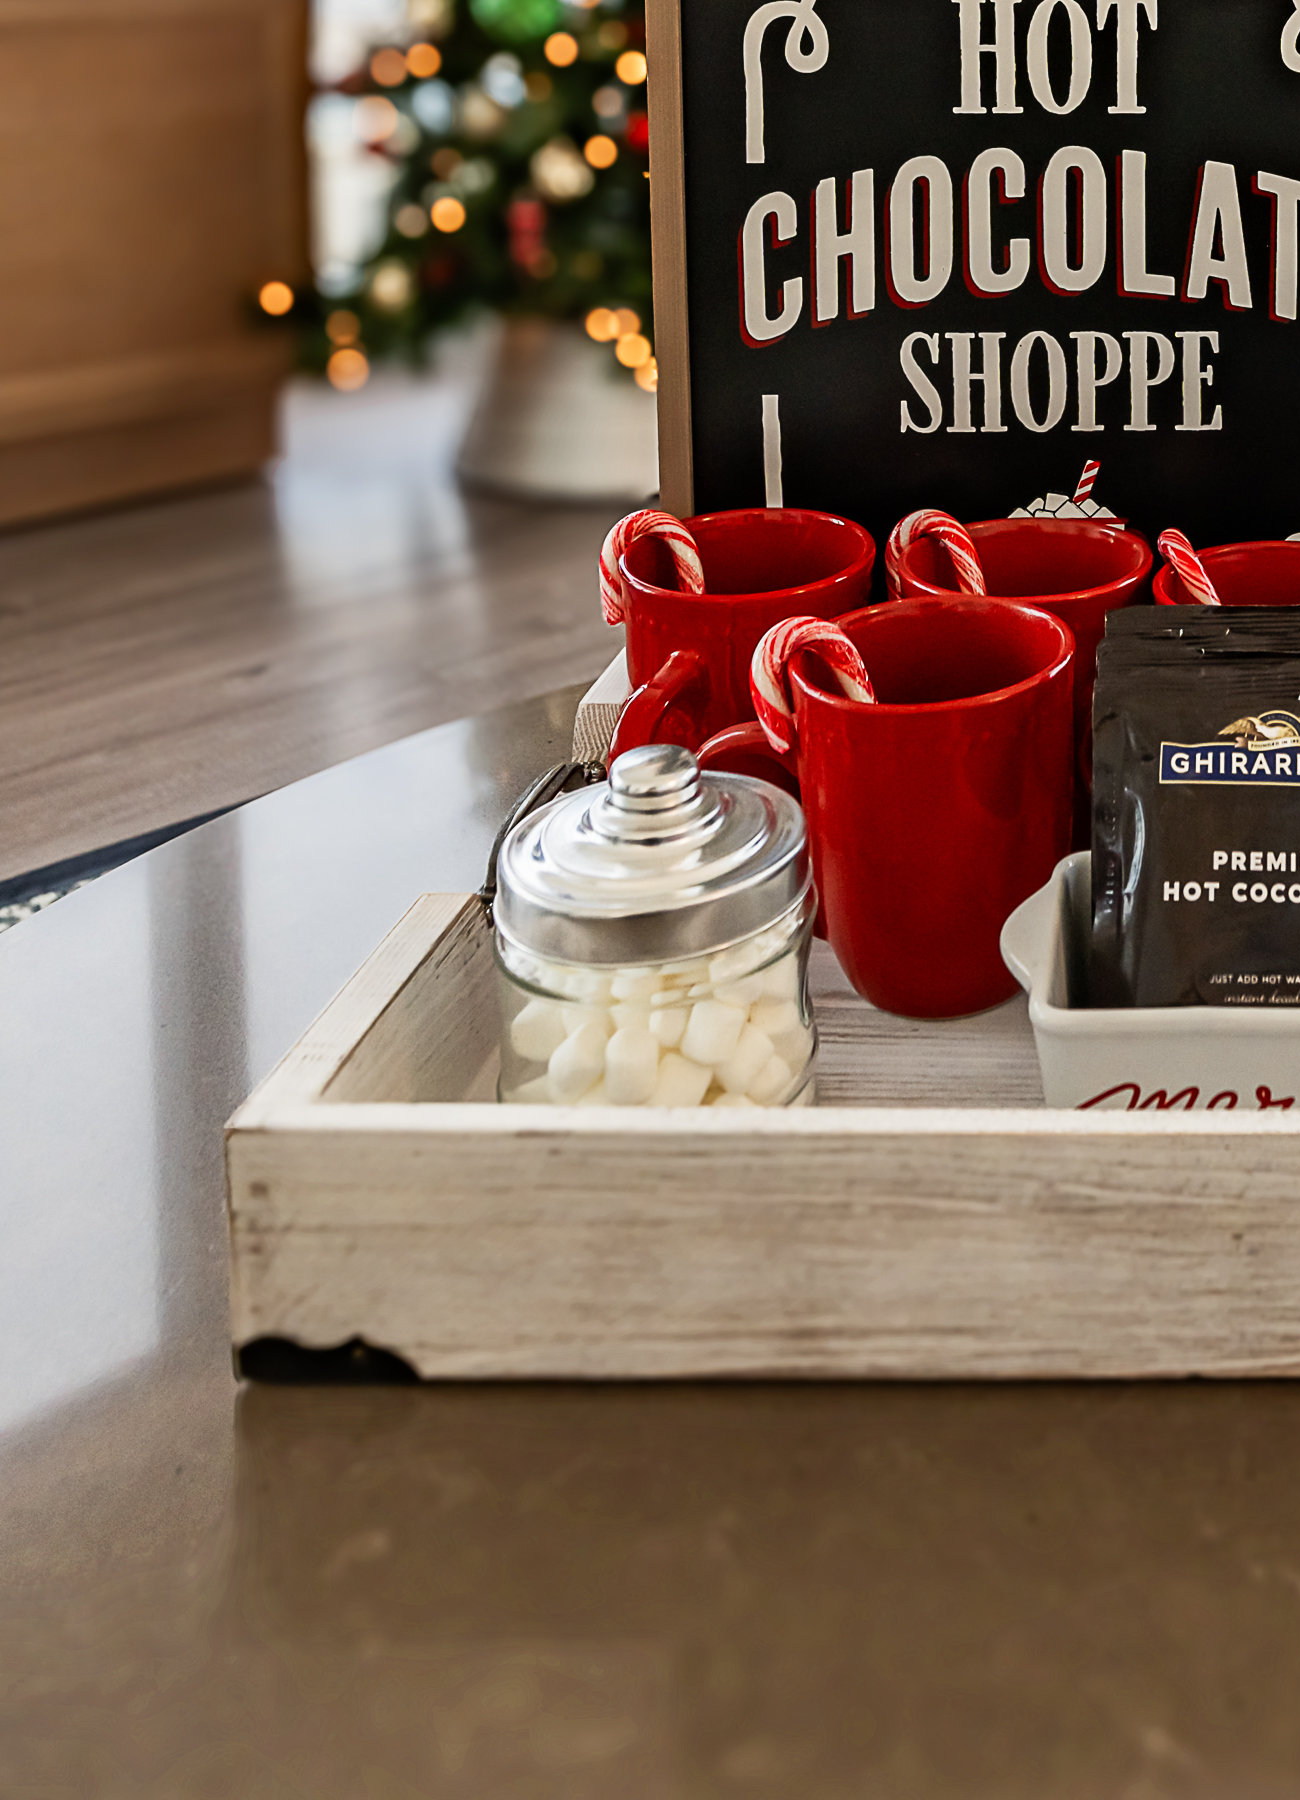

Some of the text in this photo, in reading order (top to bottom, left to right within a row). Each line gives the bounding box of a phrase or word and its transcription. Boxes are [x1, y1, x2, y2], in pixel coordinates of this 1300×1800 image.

[899, 330, 1223, 434] SHOPPE
[1162, 881, 1221, 903] HOT
[1209, 974, 1233, 984] JUST
[1237, 974, 1258, 984] ADD
[1262, 974, 1281, 984] HOT
